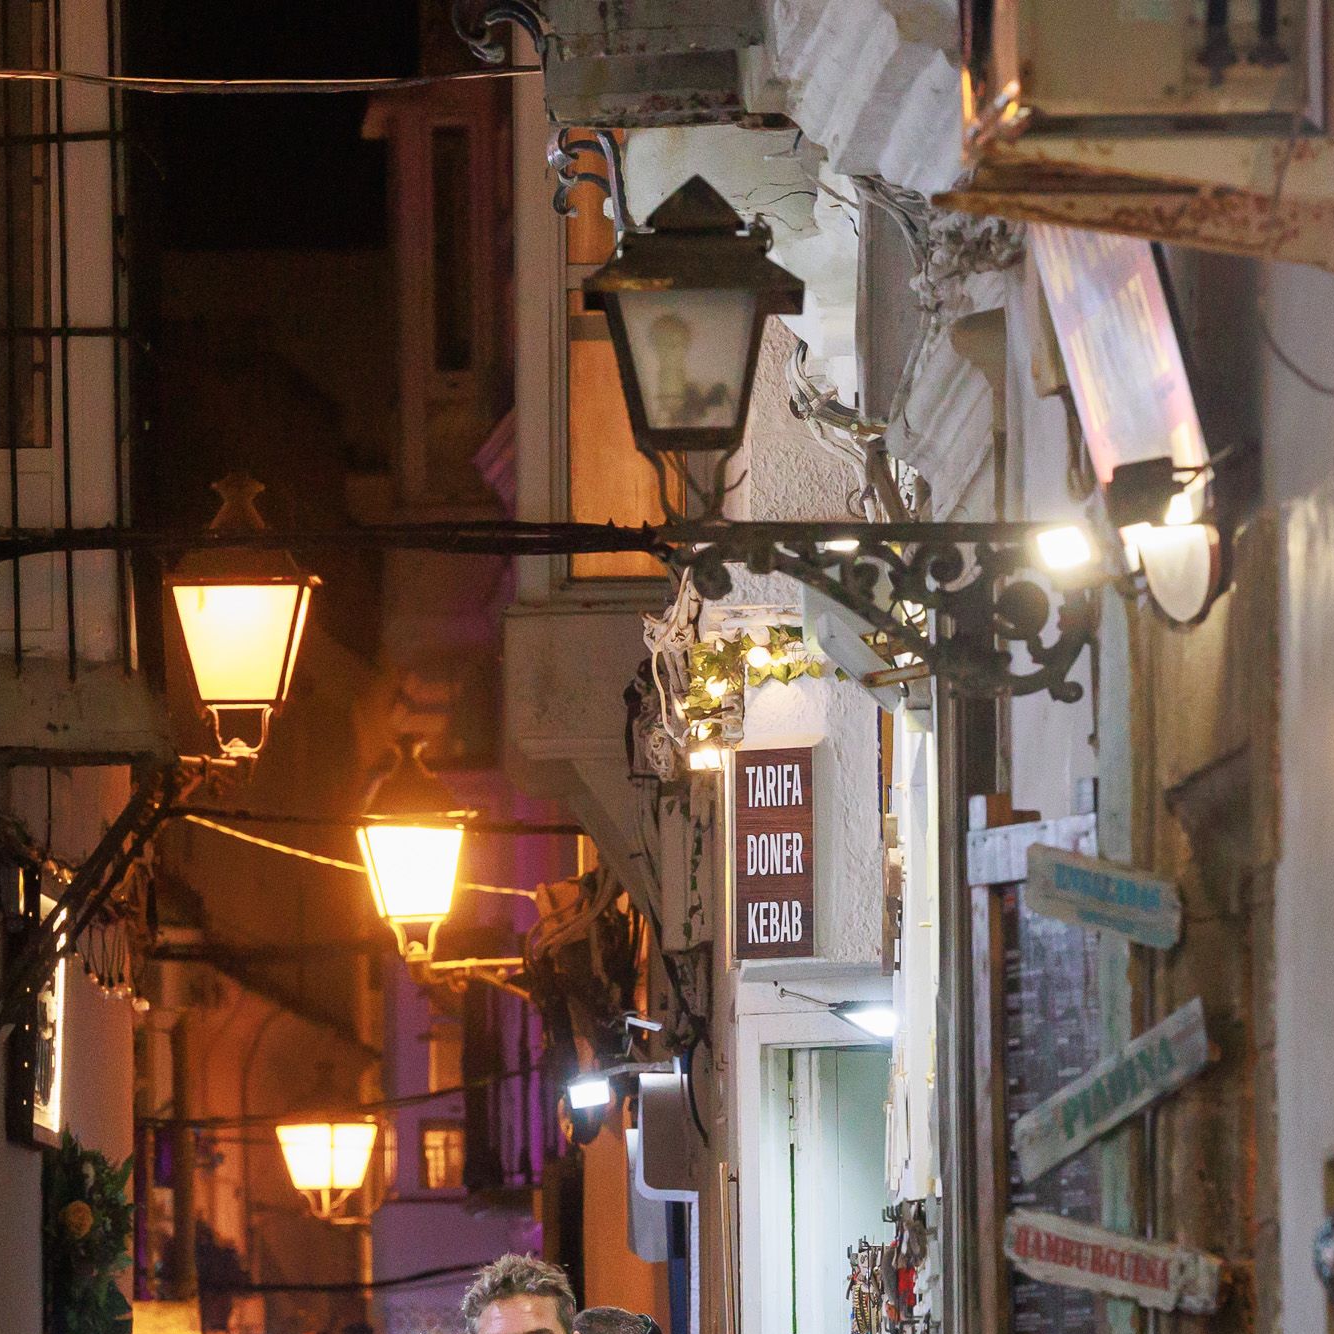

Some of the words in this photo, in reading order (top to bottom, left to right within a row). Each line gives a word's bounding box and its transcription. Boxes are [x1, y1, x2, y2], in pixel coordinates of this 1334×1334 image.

[745, 764, 803, 808] TARIFA
[746, 832, 803, 876] DONER
[747, 900, 803, 944] KEBAB
